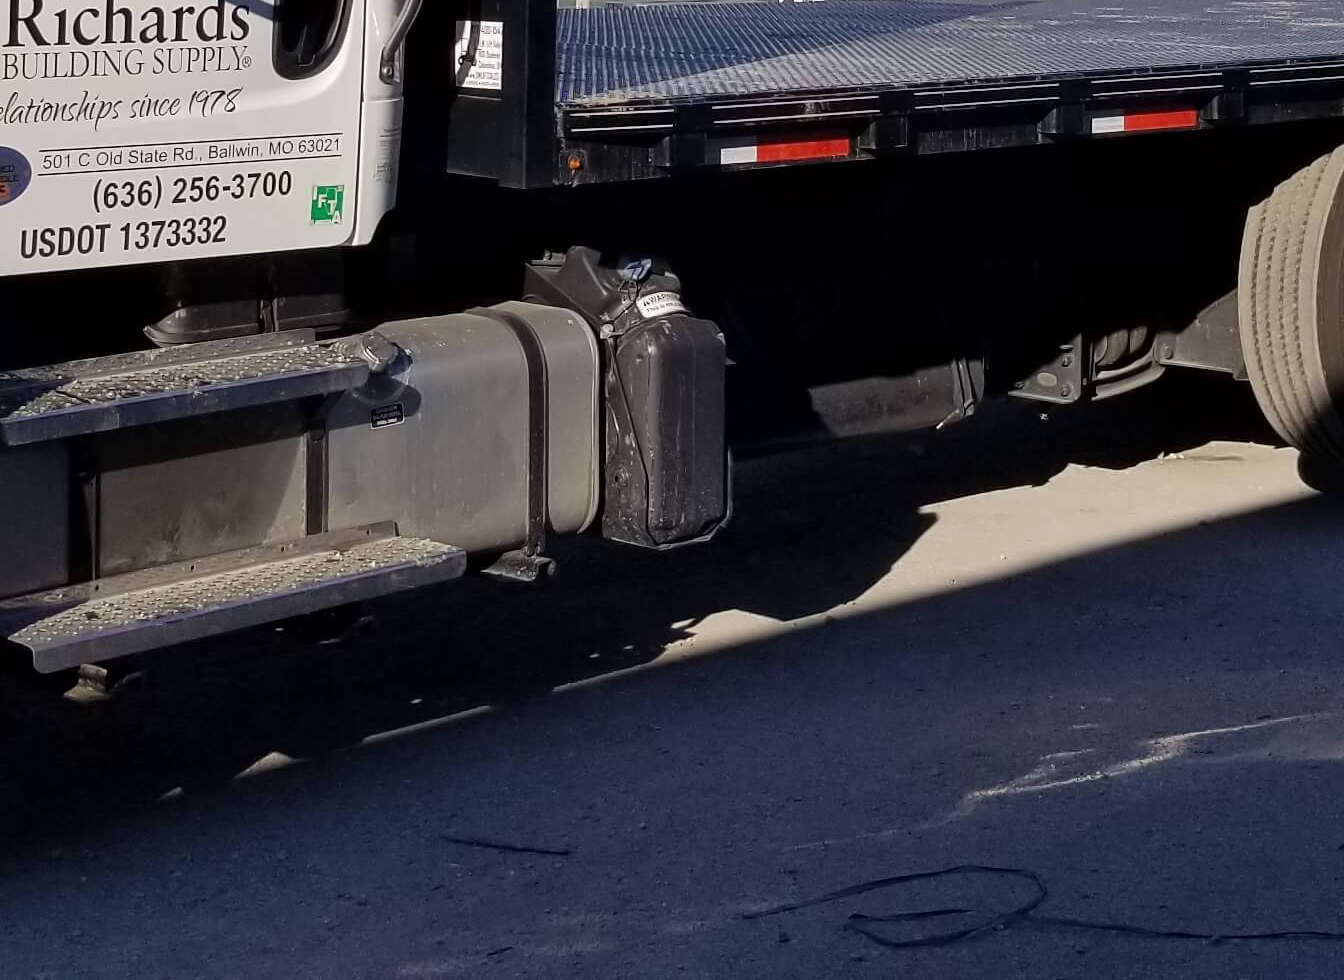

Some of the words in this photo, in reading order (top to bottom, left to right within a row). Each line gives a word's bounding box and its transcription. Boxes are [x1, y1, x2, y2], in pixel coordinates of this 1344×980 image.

[2, 49, 145, 81] BUILDING
[129, 95, 181, 118] since
[188, 85, 244, 115] 1978
[42, 156, 72, 169] 501
[78, 153, 91, 168] C
[96, 150, 123, 166] Old
[127, 147, 169, 164] State
[268, 141, 294, 155] MO
[298, 138, 341, 153] 63021
[93, 176, 163, 212] (636)
[171, 170, 292, 205] 256-3700
[20, 223, 111, 259] USDOT
[119, 215, 227, 251] 1373332
